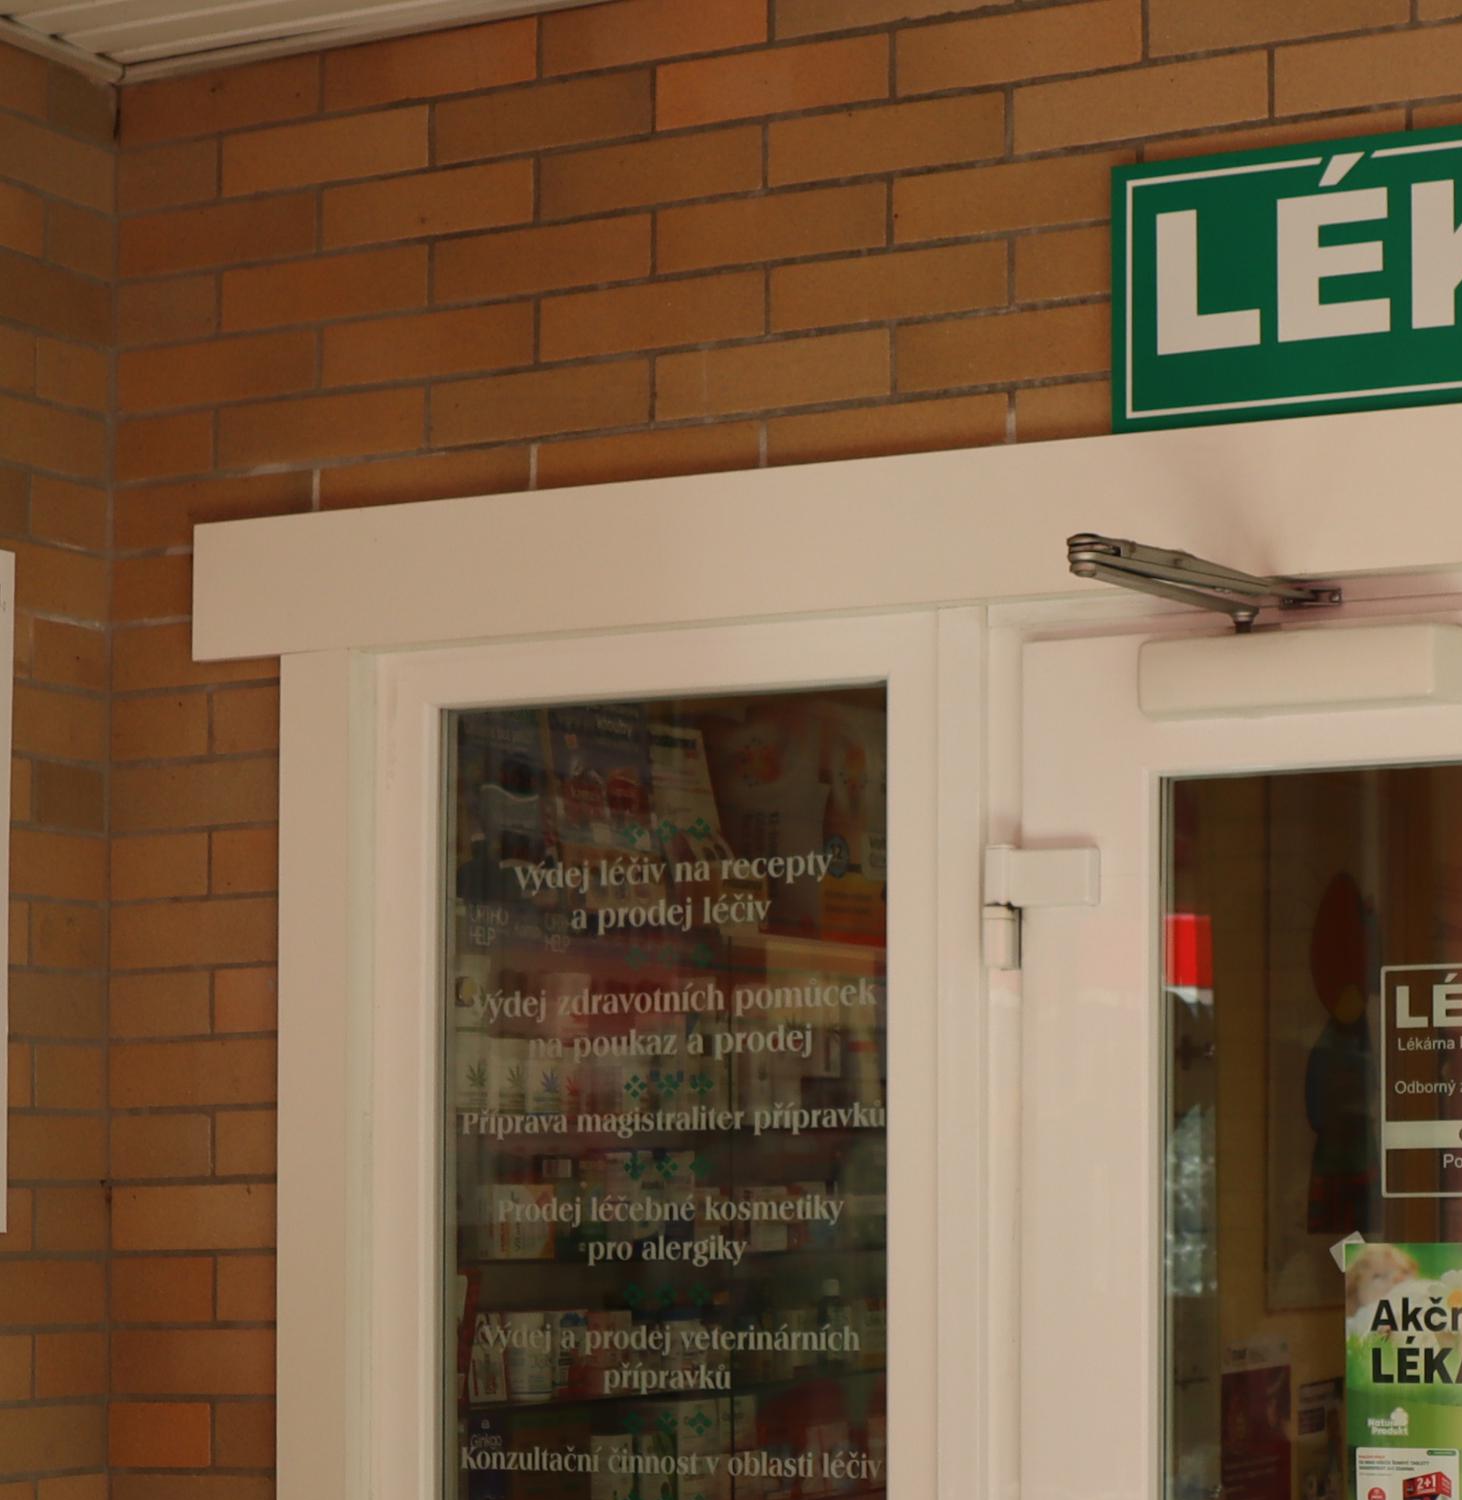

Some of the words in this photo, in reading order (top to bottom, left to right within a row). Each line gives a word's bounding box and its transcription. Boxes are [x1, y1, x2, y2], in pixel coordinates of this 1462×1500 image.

[514, 859, 589, 896] Výdej
[600, 854, 666, 886] léčiv
[675, 859, 710, 883] na
[720, 852, 833, 885] recepty
[571, 910, 587, 930] a
[598, 899, 692, 935] prodej
[703, 894, 771, 924] léčiv
[473, 988, 547, 1024] Výdej
[558, 982, 724, 1016] zdravotních
[735, 978, 878, 1016] pomůcek
[530, 1037, 562, 1059] na
[573, 1029, 677, 1063] poukaz
[687, 1034, 703, 1053] a
[714, 1024, 813, 1060] prodej
[1397, 1034, 1455, 1051] Lékárna
[1395, 1079, 1455, 1096] Odborný
[463, 1111, 567, 1140] Příprava
[577, 1105, 744, 1138] magistraliter
[754, 1100, 885, 1136] přípravků
[500, 1198, 581, 1227] Prodej
[591, 1193, 696, 1223] léčebné
[704, 1194, 844, 1227] kosmetiky
[587, 1242, 632, 1267] pro
[642, 1236, 746, 1266] alergiky
[479, 1323, 551, 1356] Výdej
[561, 1330, 576, 1349] a
[584, 1324, 671, 1357] prodej
[680, 1322, 860, 1352] veterinárních
[603, 1362, 731, 1394] přípravků
[461, 1444, 599, 1473] Konzultační
[608, 1449, 698, 1475] činnost
[705, 1458, 719, 1475] v
[728, 1451, 813, 1478] oblasti
[822, 1450, 882, 1480] léčiv
[1417, 1474, 1437, 1489] 2+1
